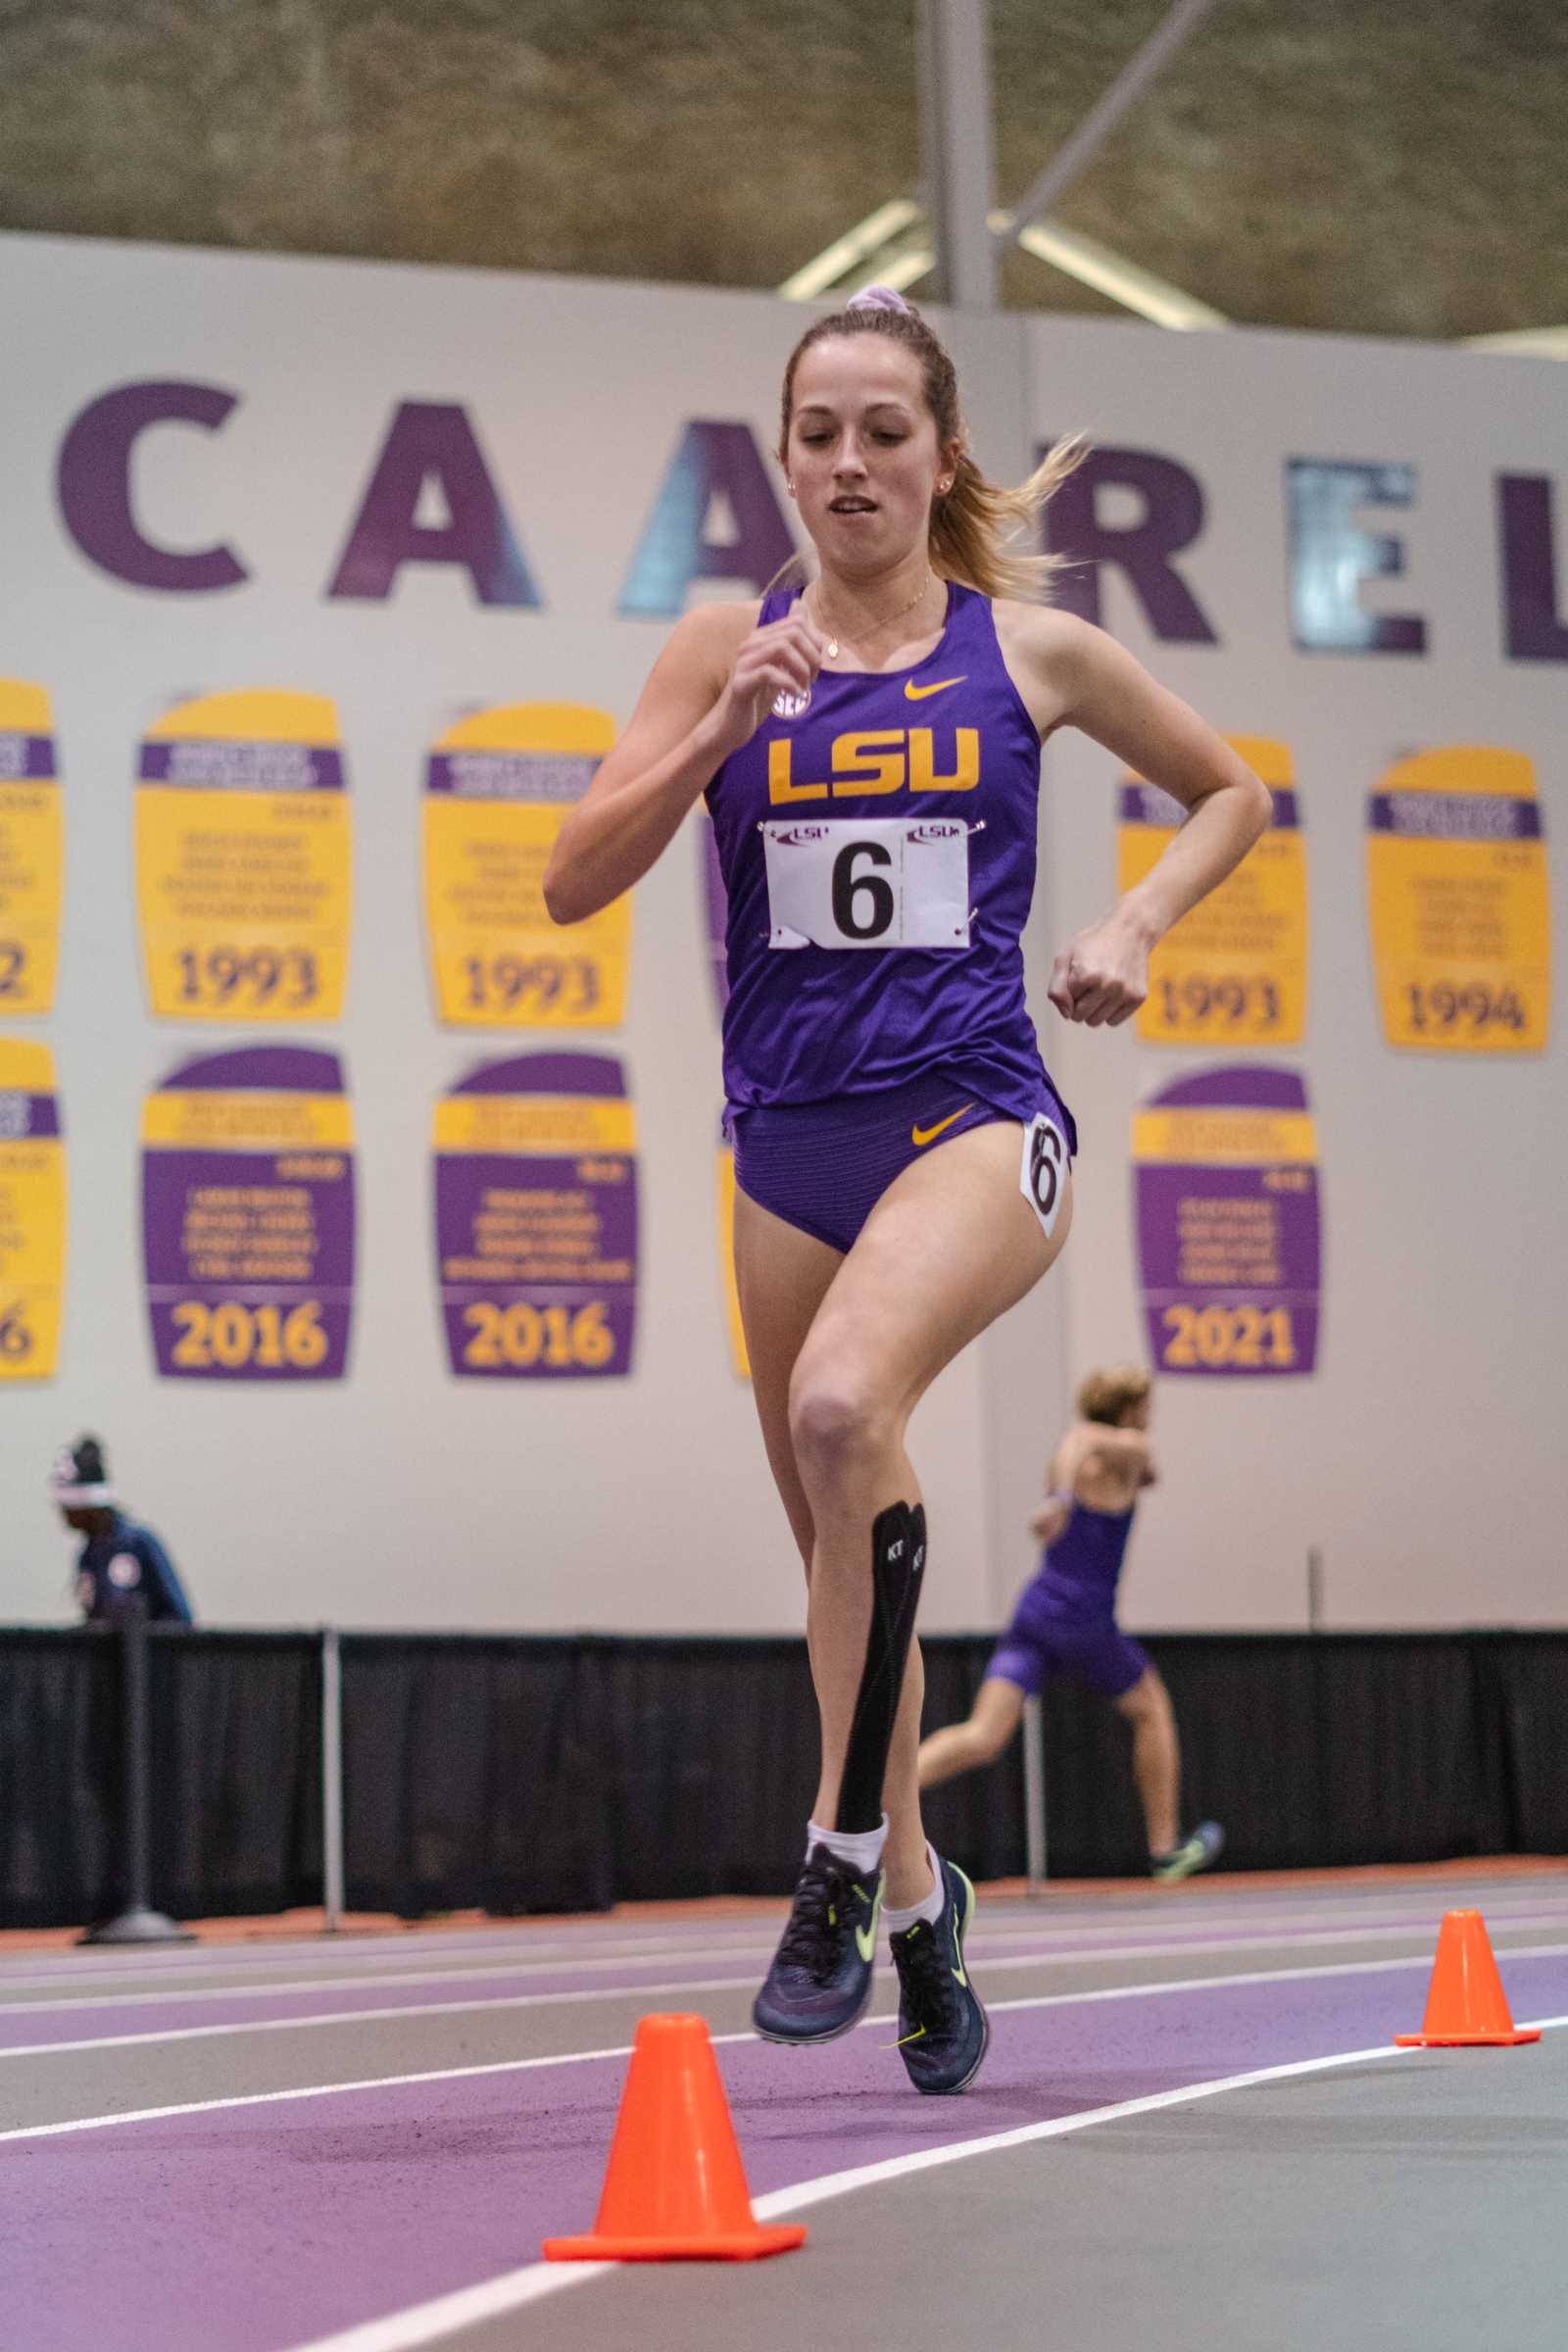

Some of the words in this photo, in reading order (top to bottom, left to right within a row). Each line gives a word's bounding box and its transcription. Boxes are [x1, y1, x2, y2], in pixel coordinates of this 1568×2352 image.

[768, 727, 980, 806] LSU
[831, 841, 894, 940] 6
[176, 945, 320, 1006] 1993
[464, 954, 603, 1015] 1993
[1409, 978, 1529, 1035] 1994
[1031, 1124, 1061, 1215] 6
[172, 1301, 328, 1368] 2016
[464, 1302, 614, 1368] 2016
[1162, 1304, 1296, 1366] 2021
[887, 1539, 904, 1561] KT
